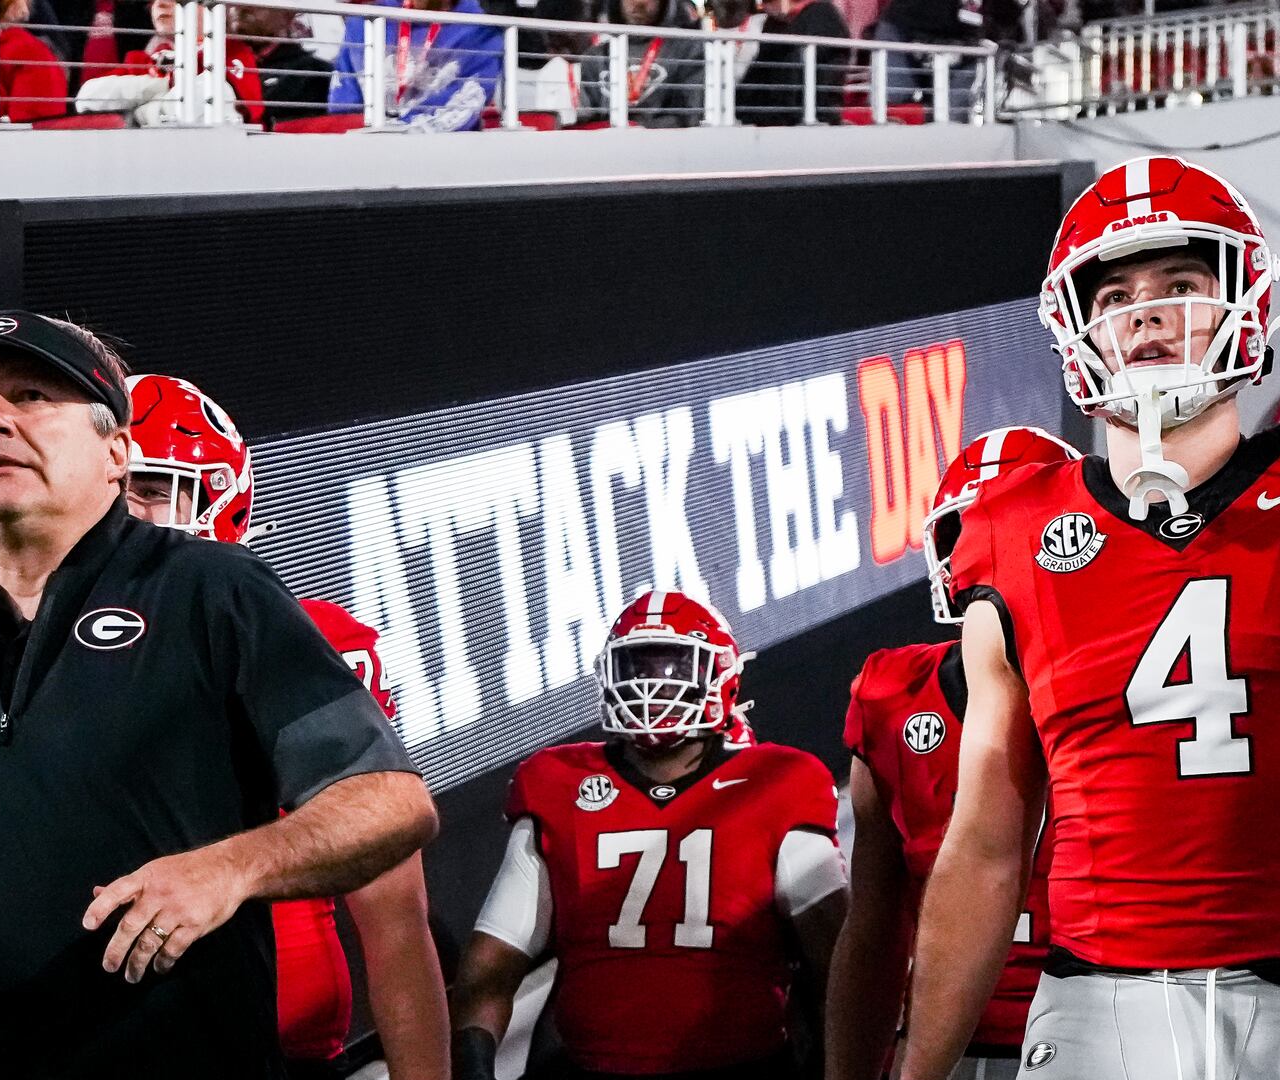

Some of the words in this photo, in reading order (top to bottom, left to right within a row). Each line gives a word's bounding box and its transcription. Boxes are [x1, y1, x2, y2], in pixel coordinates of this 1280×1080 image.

[1111, 212, 1169, 232] DAWGS
[347, 406, 711, 748] ATTACK
[708, 371, 861, 613] THE
[856, 338, 967, 567] DAY
[1045, 515, 1093, 556] SEC
[1160, 515, 1202, 538] G
[1042, 545, 1099, 572] GRADUATE
[76, 609, 144, 649] G
[1126, 579, 1250, 778] 4
[906, 714, 942, 750] SEC
[581, 776, 610, 800] SEC
[597, 829, 713, 948] 71
